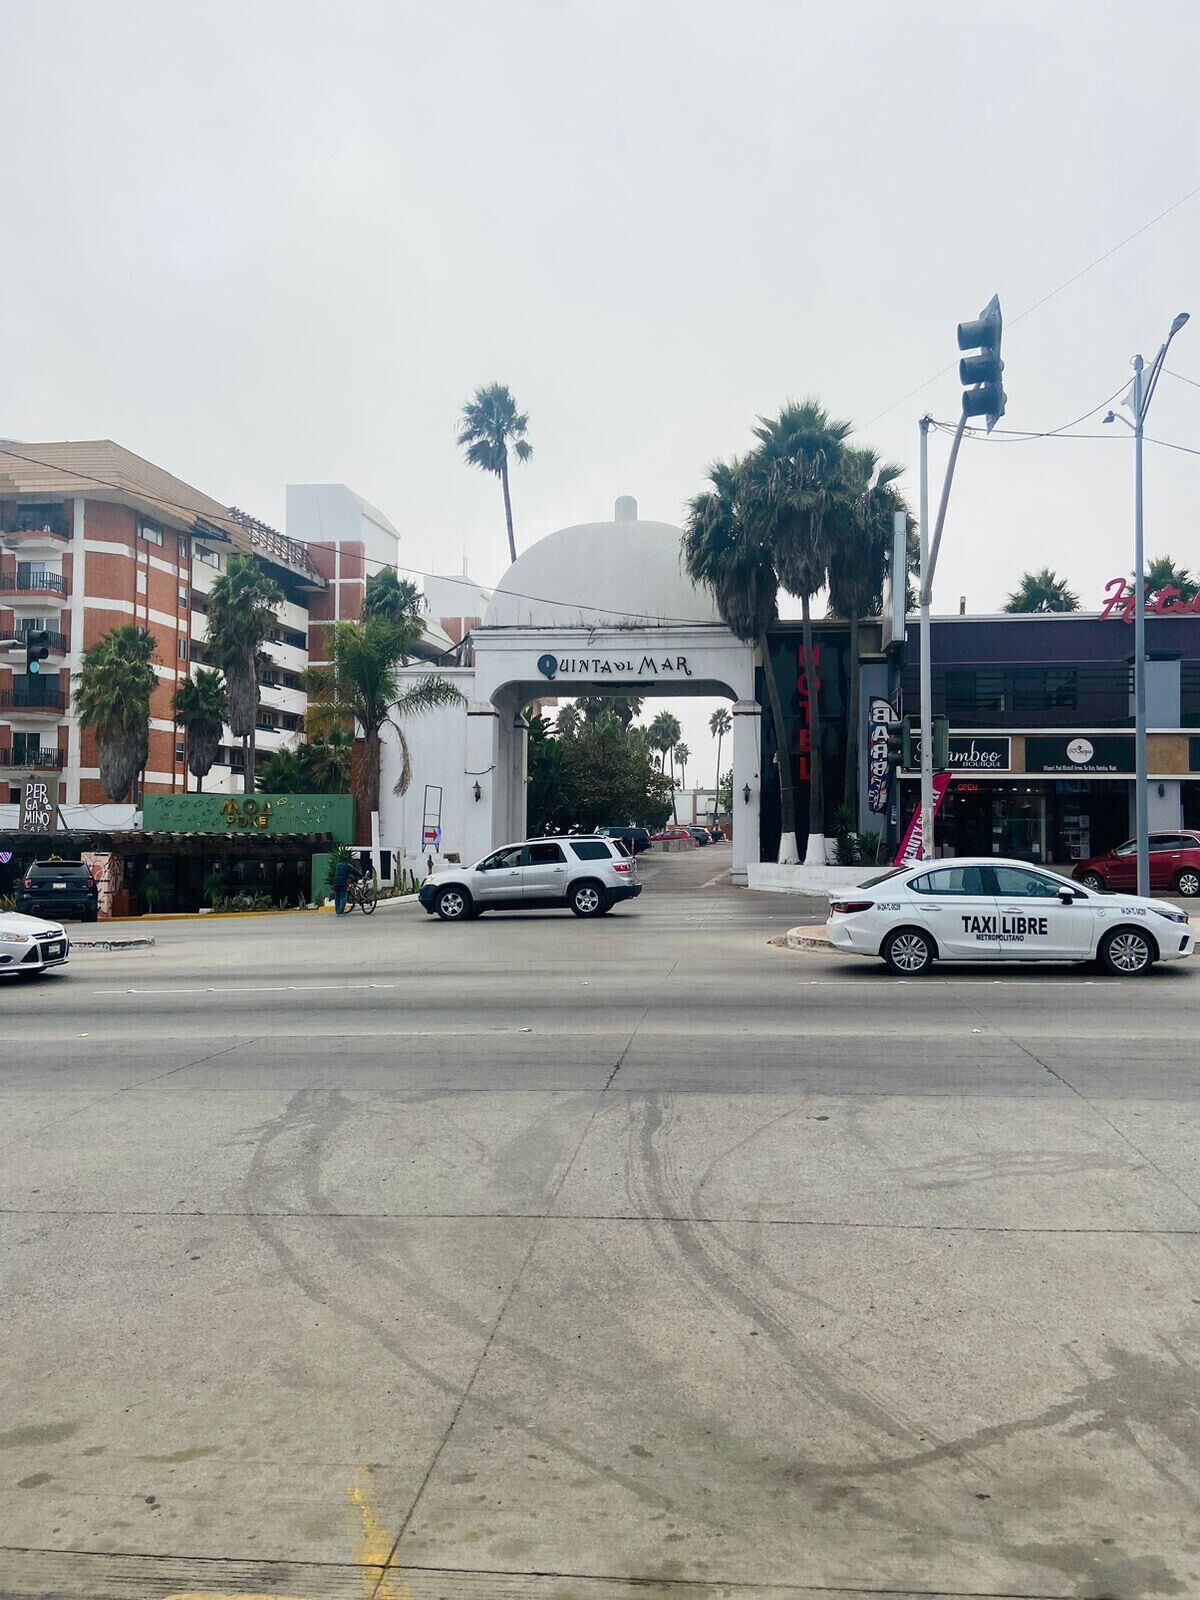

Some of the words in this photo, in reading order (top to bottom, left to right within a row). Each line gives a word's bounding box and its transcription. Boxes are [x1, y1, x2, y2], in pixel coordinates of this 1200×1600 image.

[1099, 577, 1200, 624] Hte
[537, 654, 612, 681] QUINTA
[637, 656, 693, 676] MAR
[26, 783, 47, 802] PER
[25, 797, 38, 810] GA
[220, 798, 273, 815] MOA
[24, 811, 50, 826] MINO
[961, 915, 997, 934] TAXI
[1002, 916, 1048, 935] LIBRE
[976, 934, 1024, 942] METROPOLITANO
